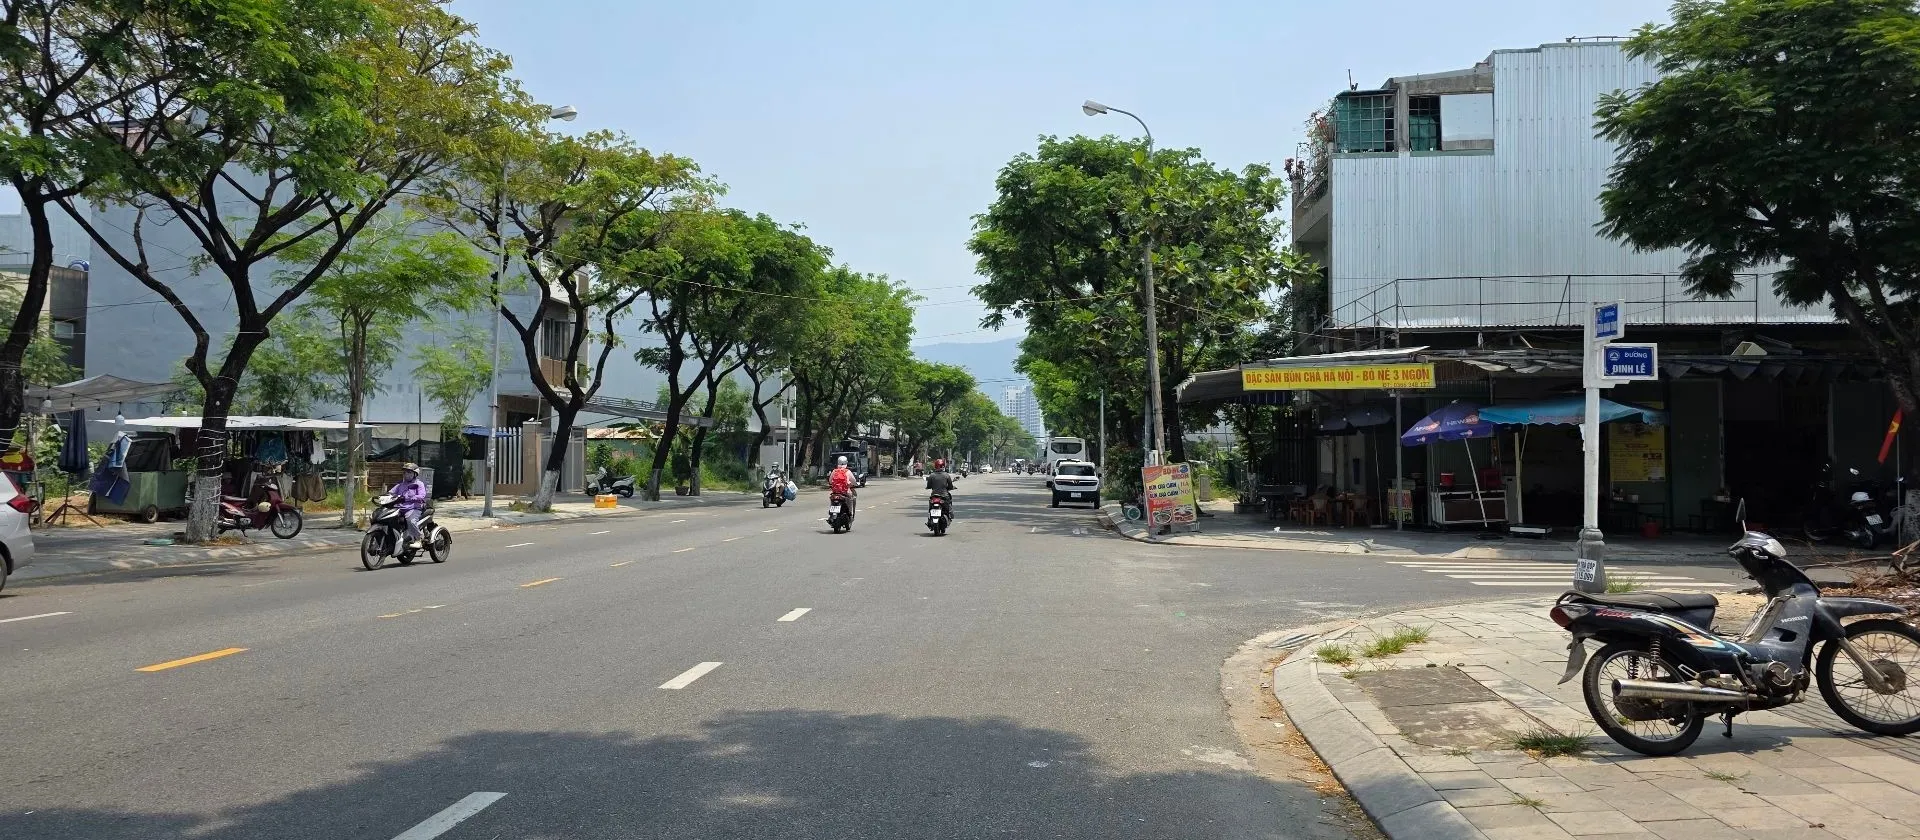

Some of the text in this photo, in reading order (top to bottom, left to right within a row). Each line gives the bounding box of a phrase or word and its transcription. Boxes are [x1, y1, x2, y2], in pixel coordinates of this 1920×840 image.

[1624, 350, 1648, 359] ĐƯỜNG
[1612, 364, 1633, 374] ĐINH
[1245, 371, 1262, 386] ĐẶC
[1264, 369, 1281, 383] SẢN
[1283, 369, 1301, 383] BÚN
[1303, 368, 1321, 382] CHẢ
[1323, 368, 1336, 382] HÀ
[1337, 368, 1353, 384] NỘI
[1378, 367, 1390, 381] NÉ
[1393, 369, 1399, 381] 3
[1401, 368, 1430, 381] NGON
[1780, 615, 1809, 623] HONDA
